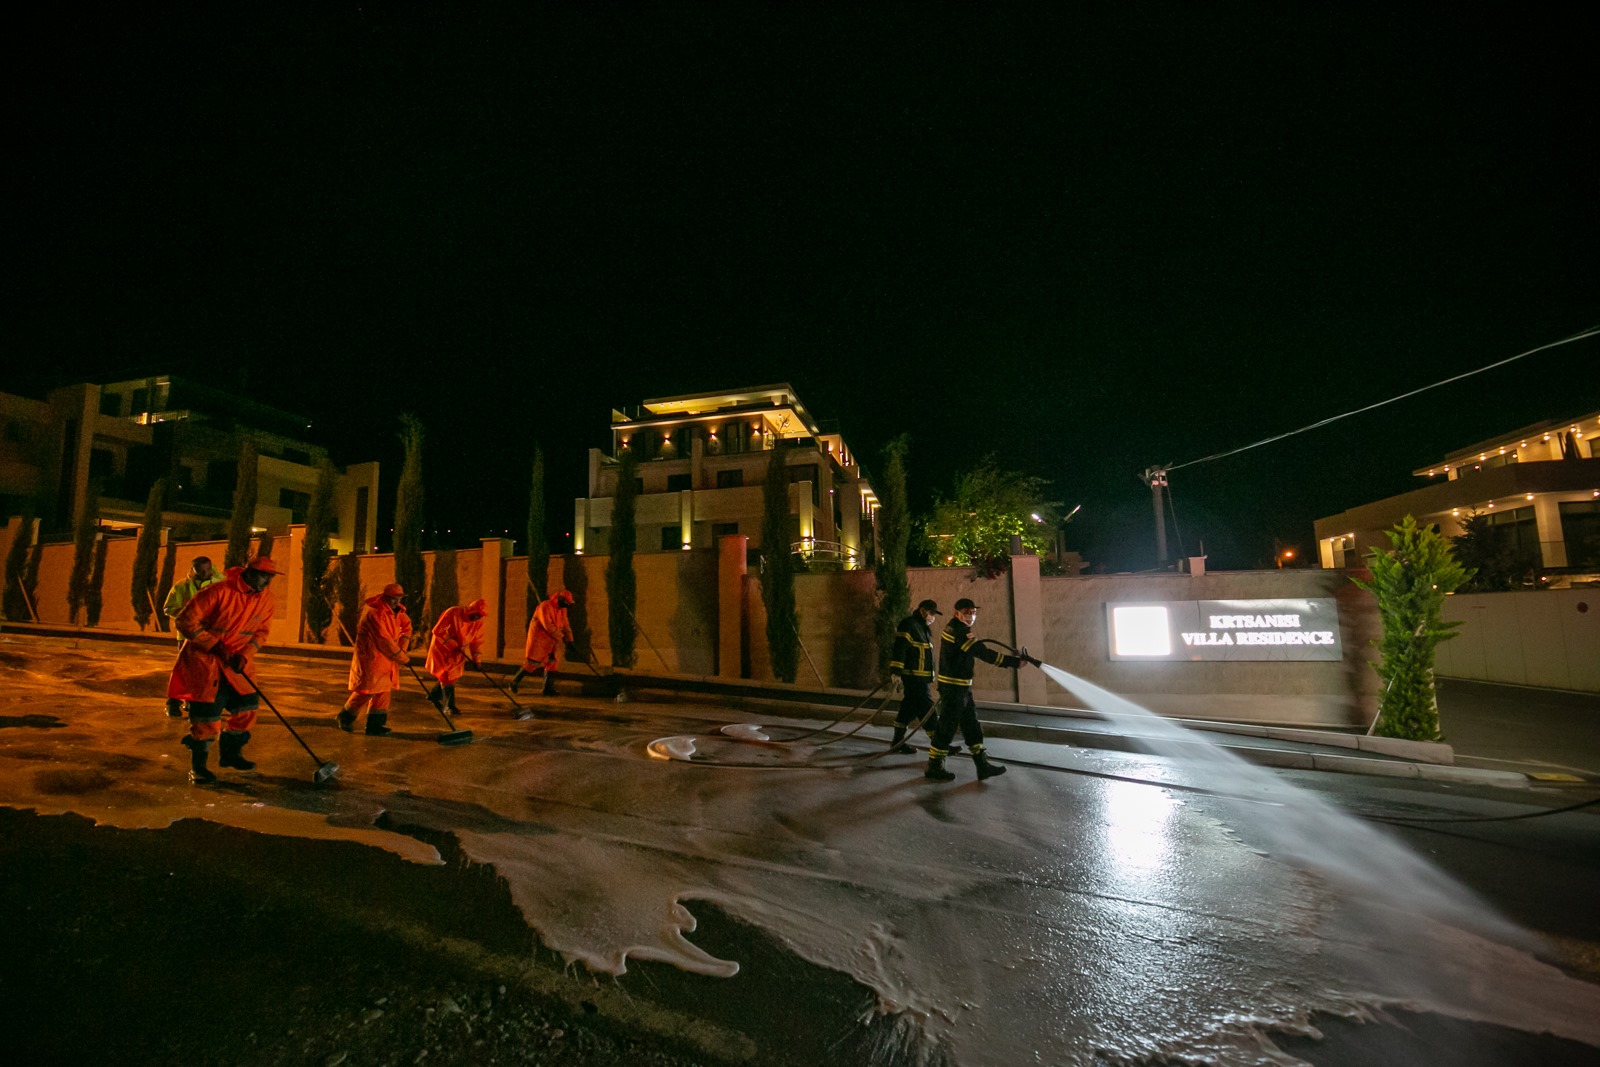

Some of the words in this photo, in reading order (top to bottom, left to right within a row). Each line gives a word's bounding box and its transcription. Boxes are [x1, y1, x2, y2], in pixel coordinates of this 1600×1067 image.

[1209, 614, 1301, 628] KRTSANISI
[1181, 632, 1234, 646] VILLA
[1235, 631, 1335, 646] RESIDENCE
